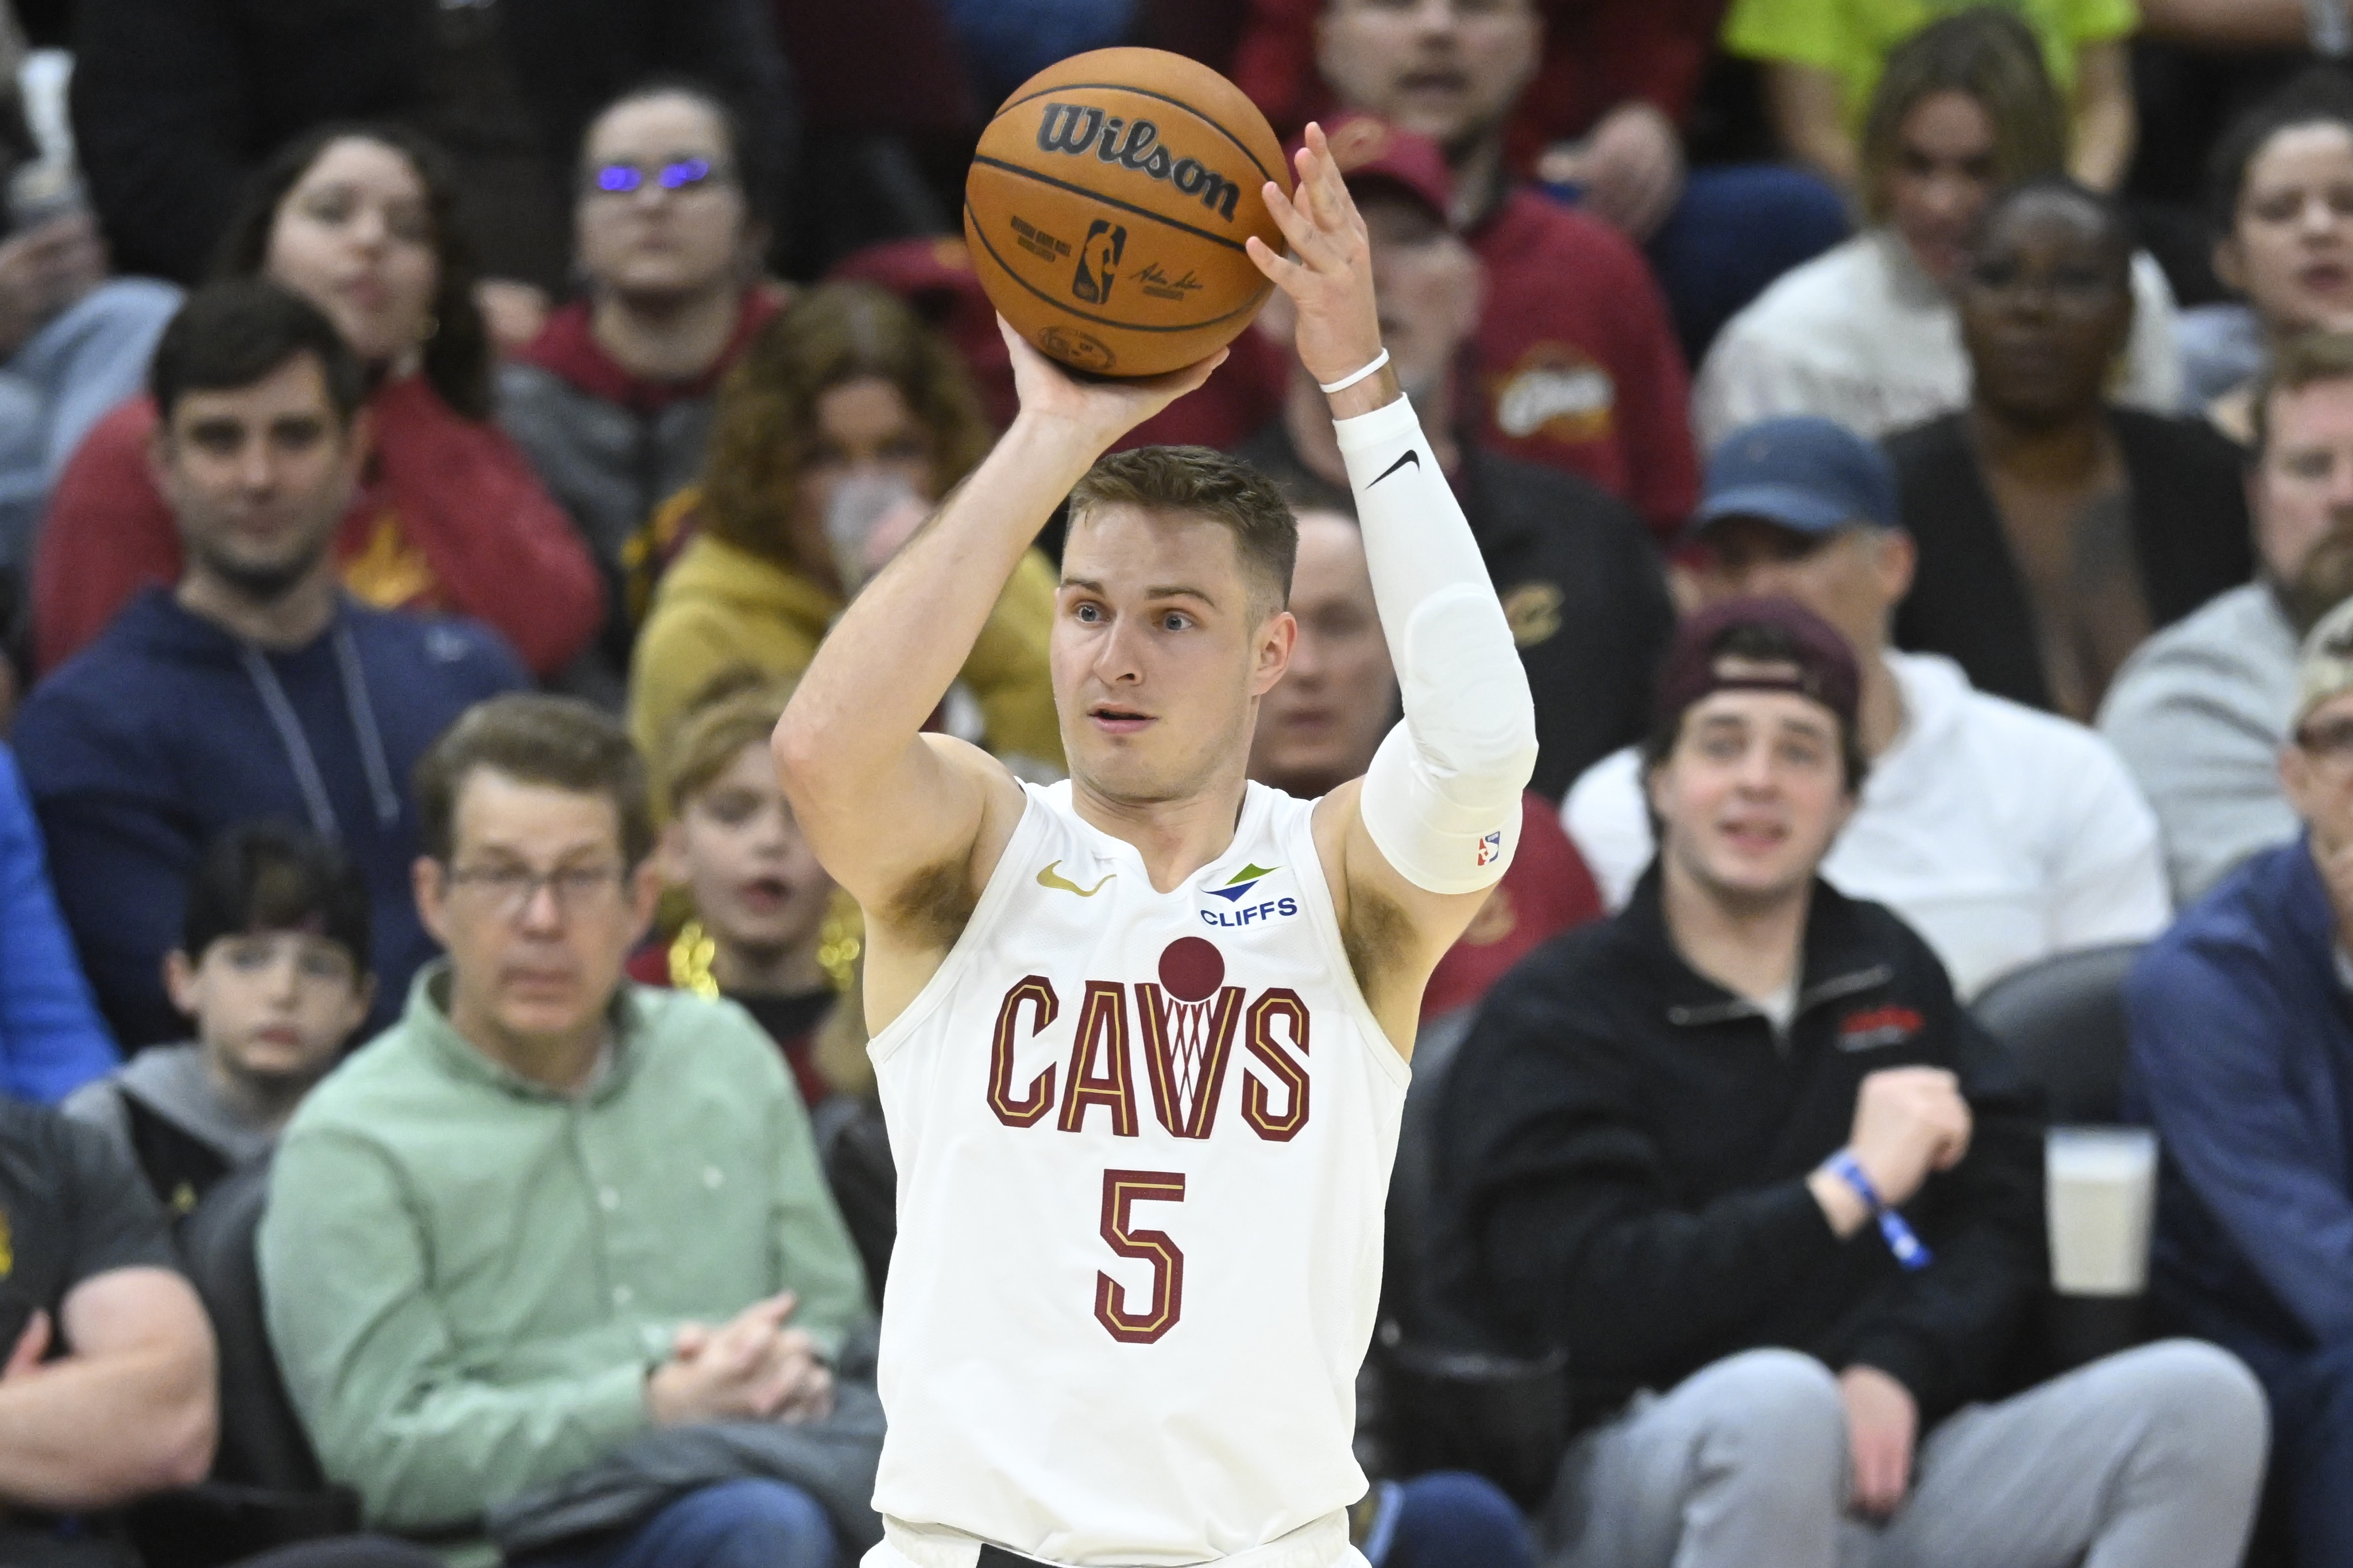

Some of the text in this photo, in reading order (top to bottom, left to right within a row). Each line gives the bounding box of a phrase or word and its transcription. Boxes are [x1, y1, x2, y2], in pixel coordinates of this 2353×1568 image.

[1037, 103, 1240, 222] Wilson
[1200, 897, 1297, 927] CLIFFS
[986, 974, 1310, 1142] CAVS
[1094, 1169, 1185, 1344] 5
